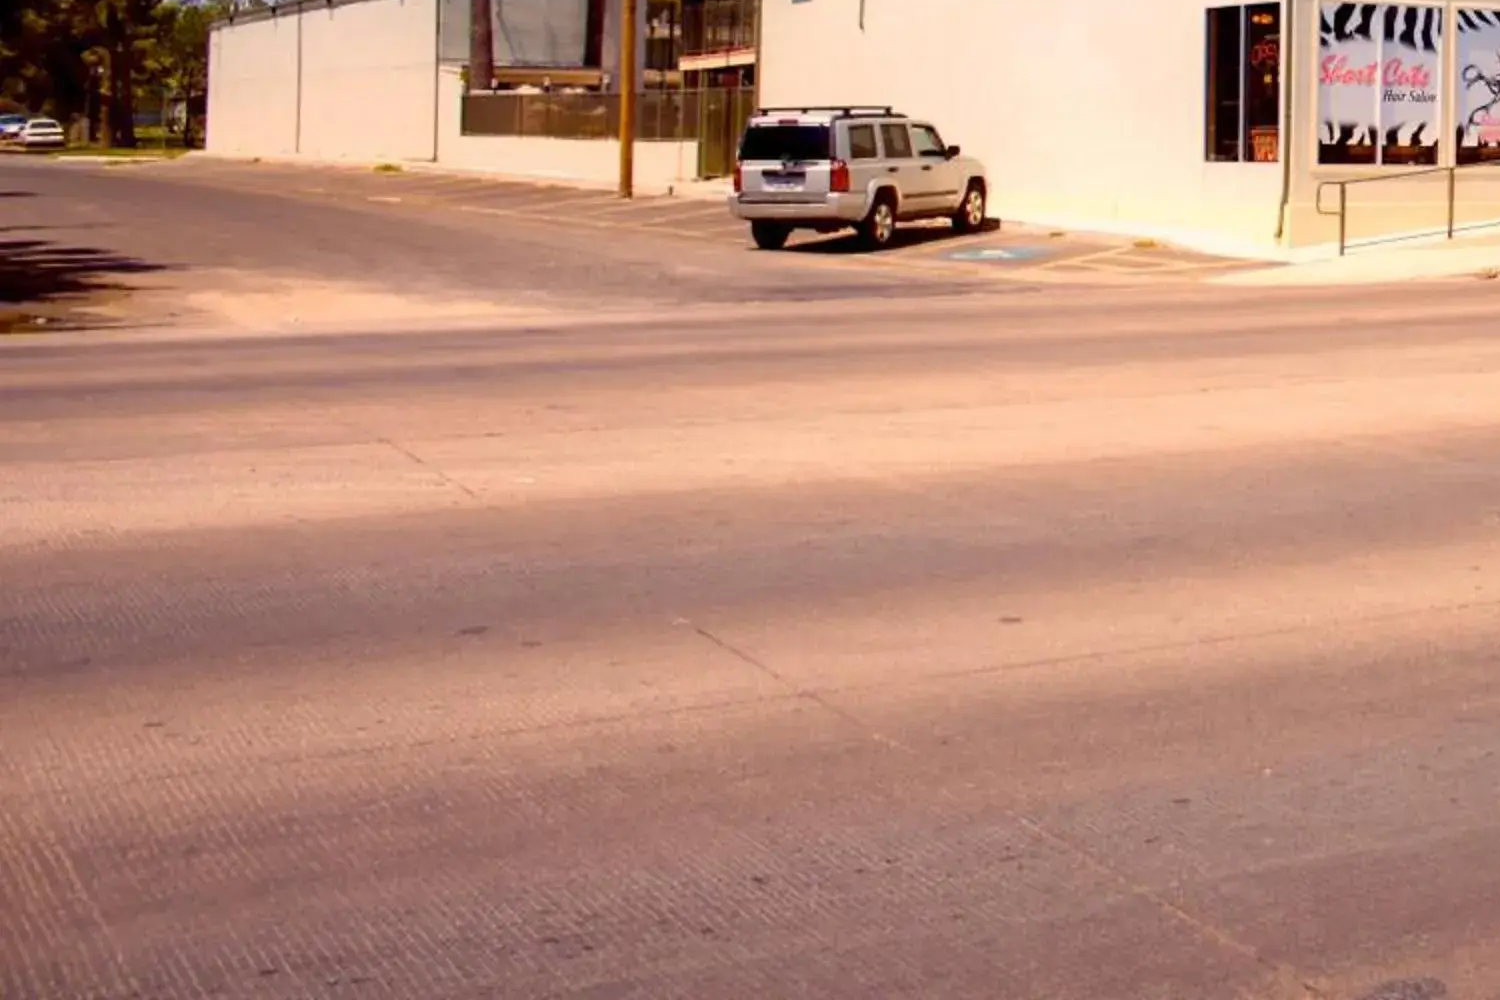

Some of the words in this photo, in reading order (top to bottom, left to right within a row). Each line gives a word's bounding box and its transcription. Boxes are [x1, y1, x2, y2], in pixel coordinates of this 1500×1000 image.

[1320, 54, 1378, 86] Short
[1382, 57, 1430, 87] Cuts
[1383, 89, 1406, 103] Hair
[1408, 89, 1438, 103] Salon
